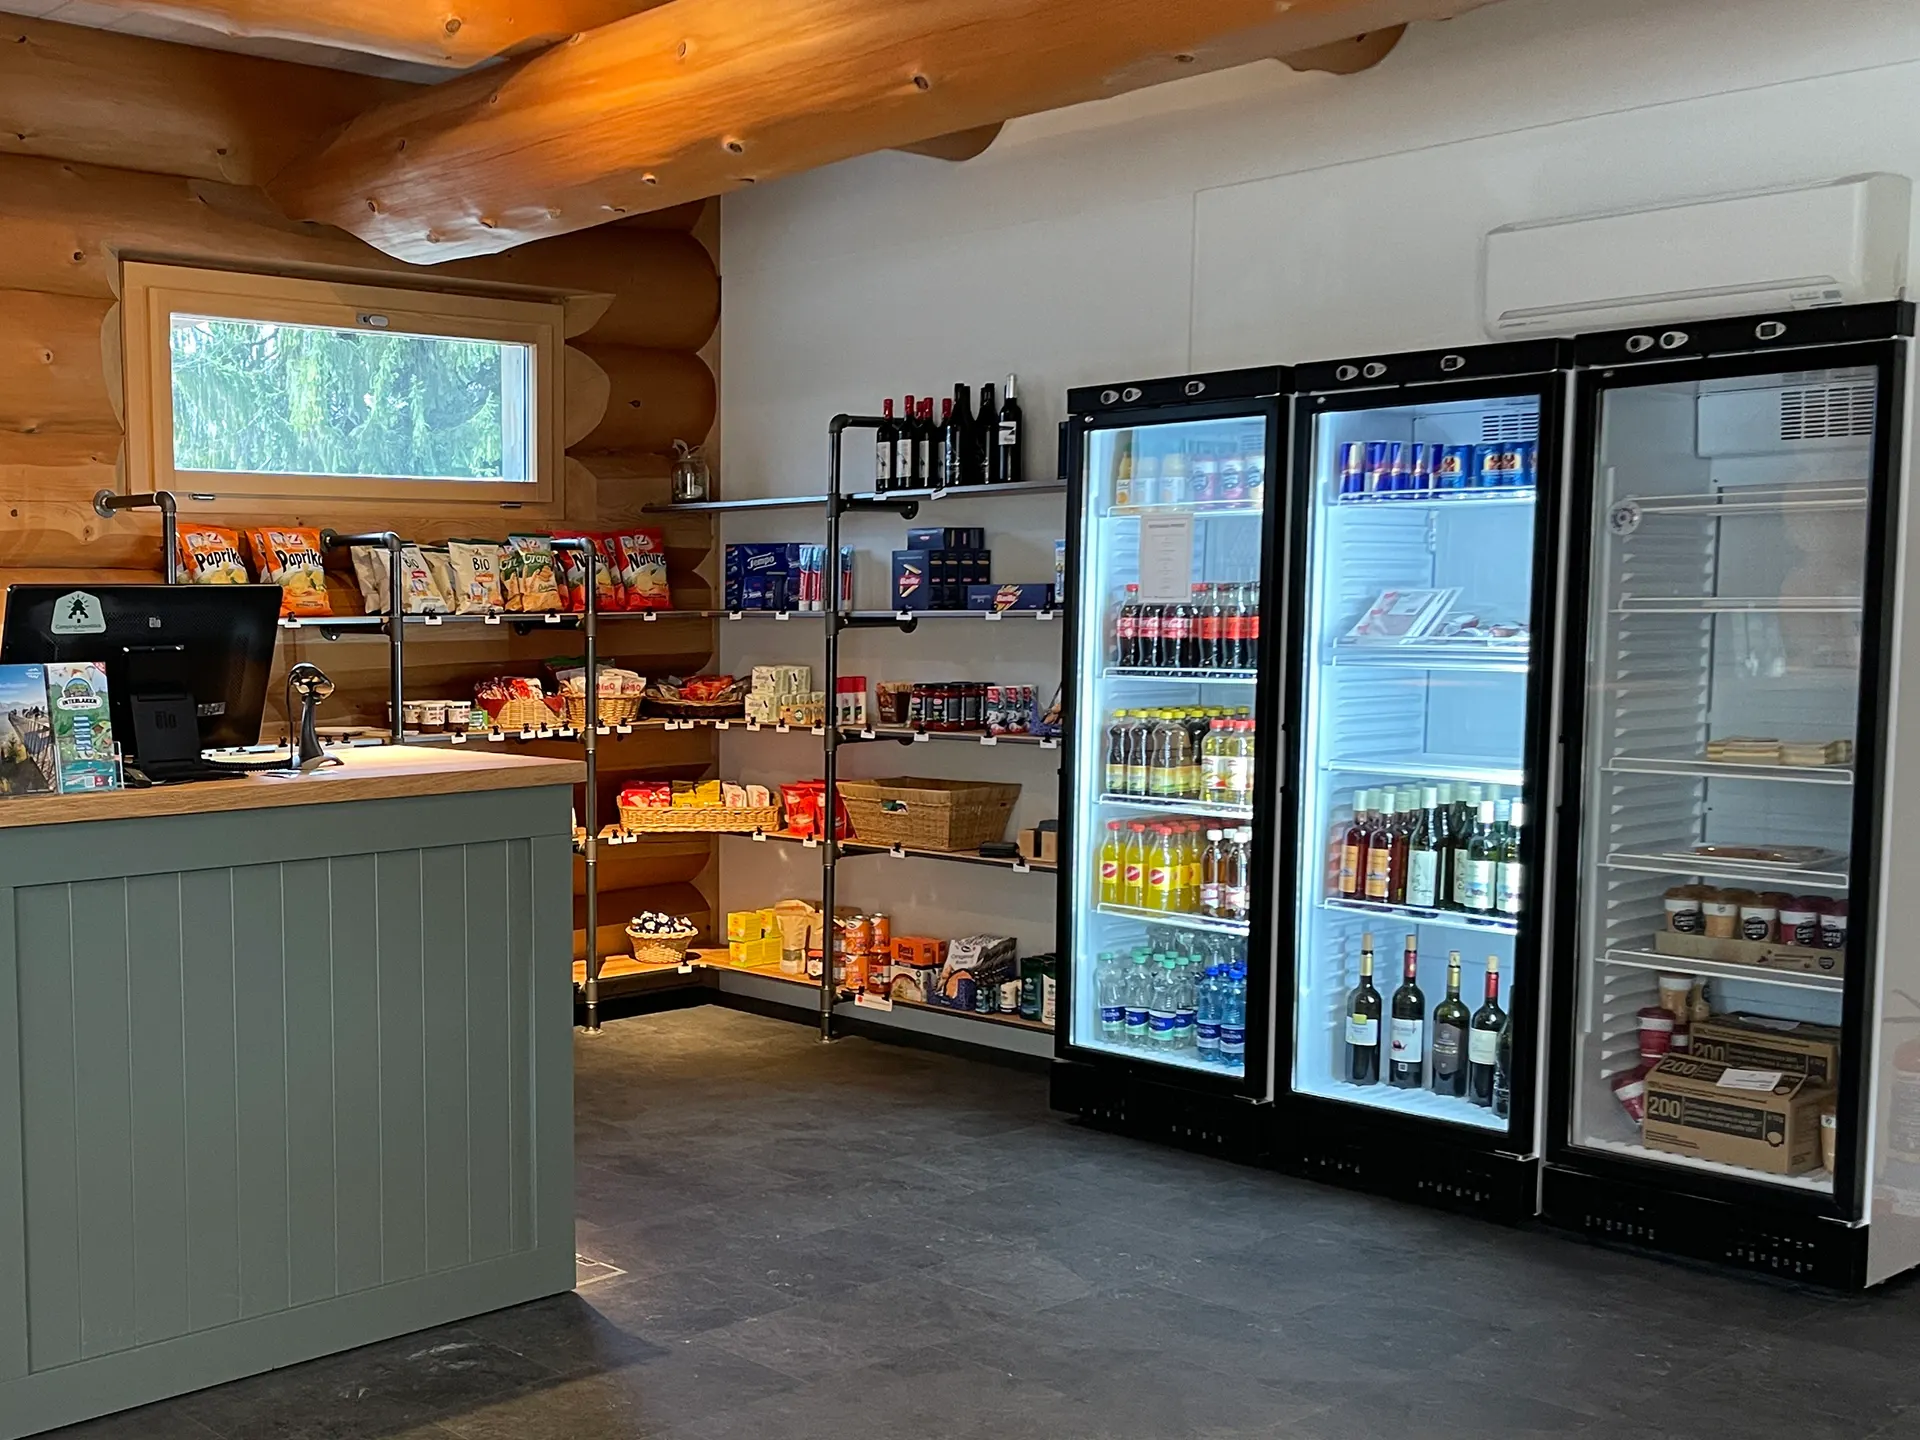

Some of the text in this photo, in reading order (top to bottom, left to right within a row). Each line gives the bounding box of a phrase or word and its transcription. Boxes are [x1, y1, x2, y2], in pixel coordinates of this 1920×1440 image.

[472, 557, 490, 571] BIO
[627, 552, 666, 572] Nature
[748, 555, 775, 569] Tempo
[1693, 1041, 1725, 1061] 200
[1659, 1058, 1698, 1075] 200
[1649, 1096, 1681, 1119] 200
